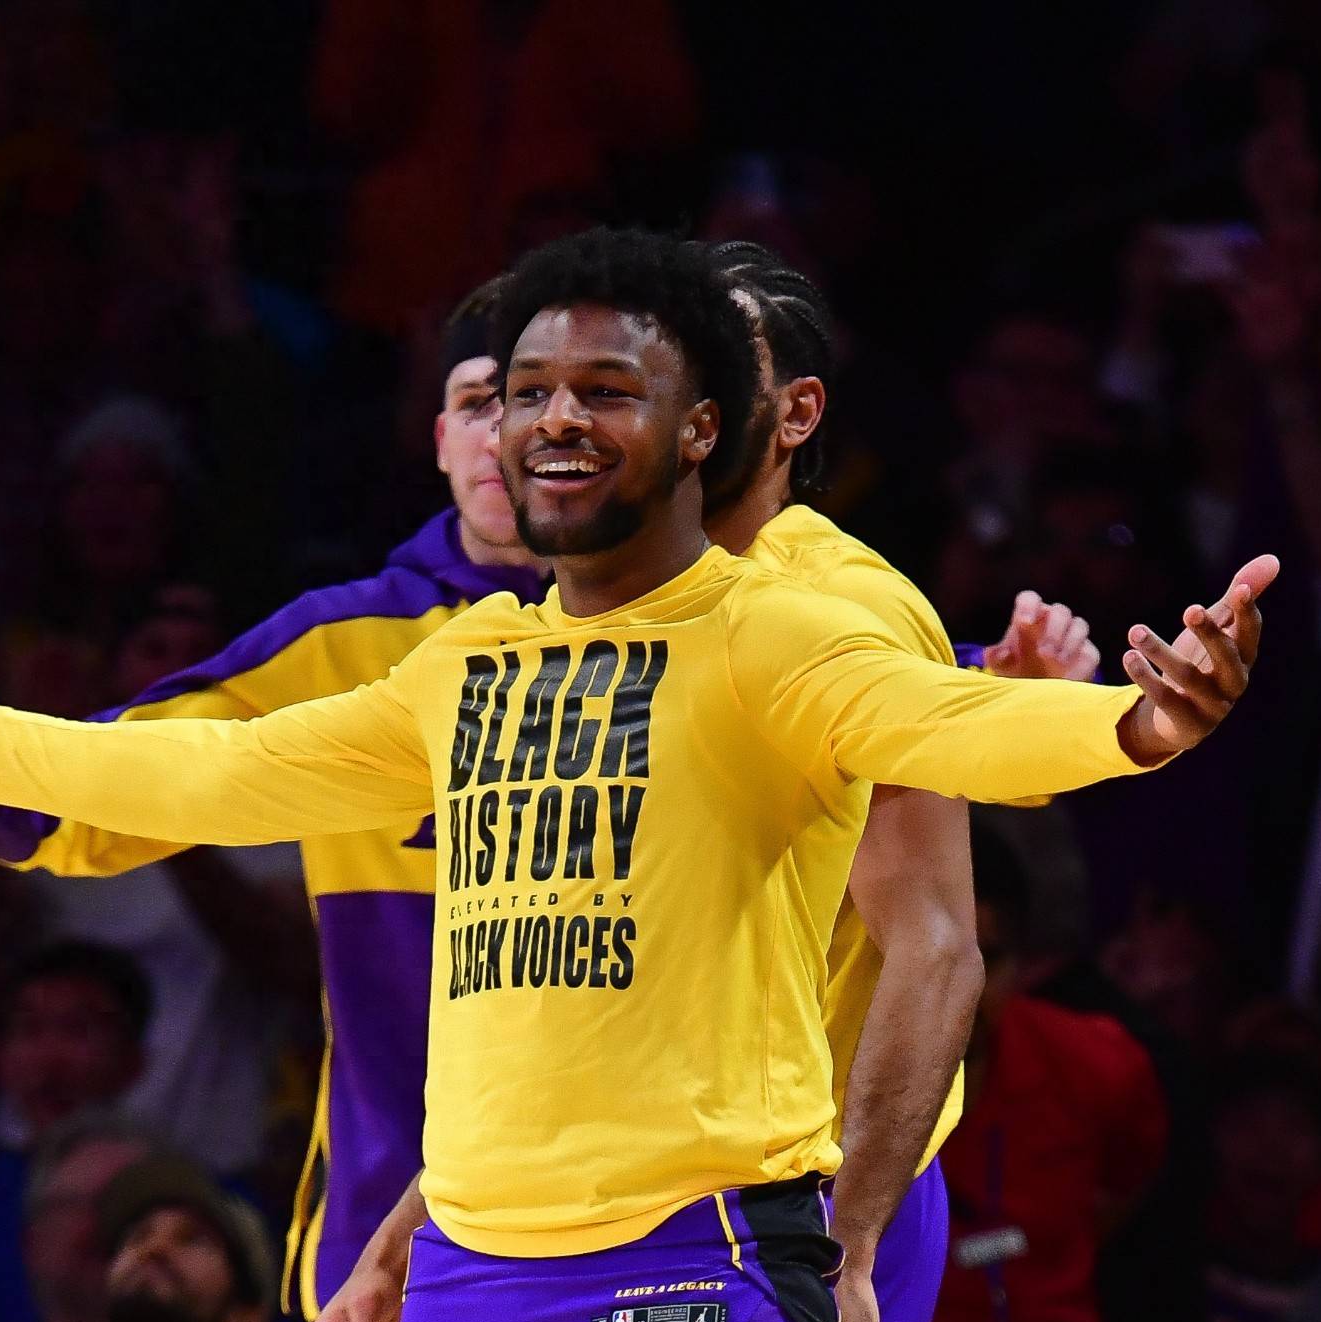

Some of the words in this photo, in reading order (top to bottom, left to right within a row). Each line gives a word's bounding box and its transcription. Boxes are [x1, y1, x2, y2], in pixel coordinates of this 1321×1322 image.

[446, 638, 669, 793] BLACK
[448, 784, 647, 892] HISTORY
[450, 892, 559, 920] ELEVATED
[593, 893, 633, 907] BY
[511, 914, 637, 991] VOICES
[614, 1286, 655, 1298] LEAVE
[655, 1285, 666, 1293] A
[666, 1281, 727, 1293] LEGACY
